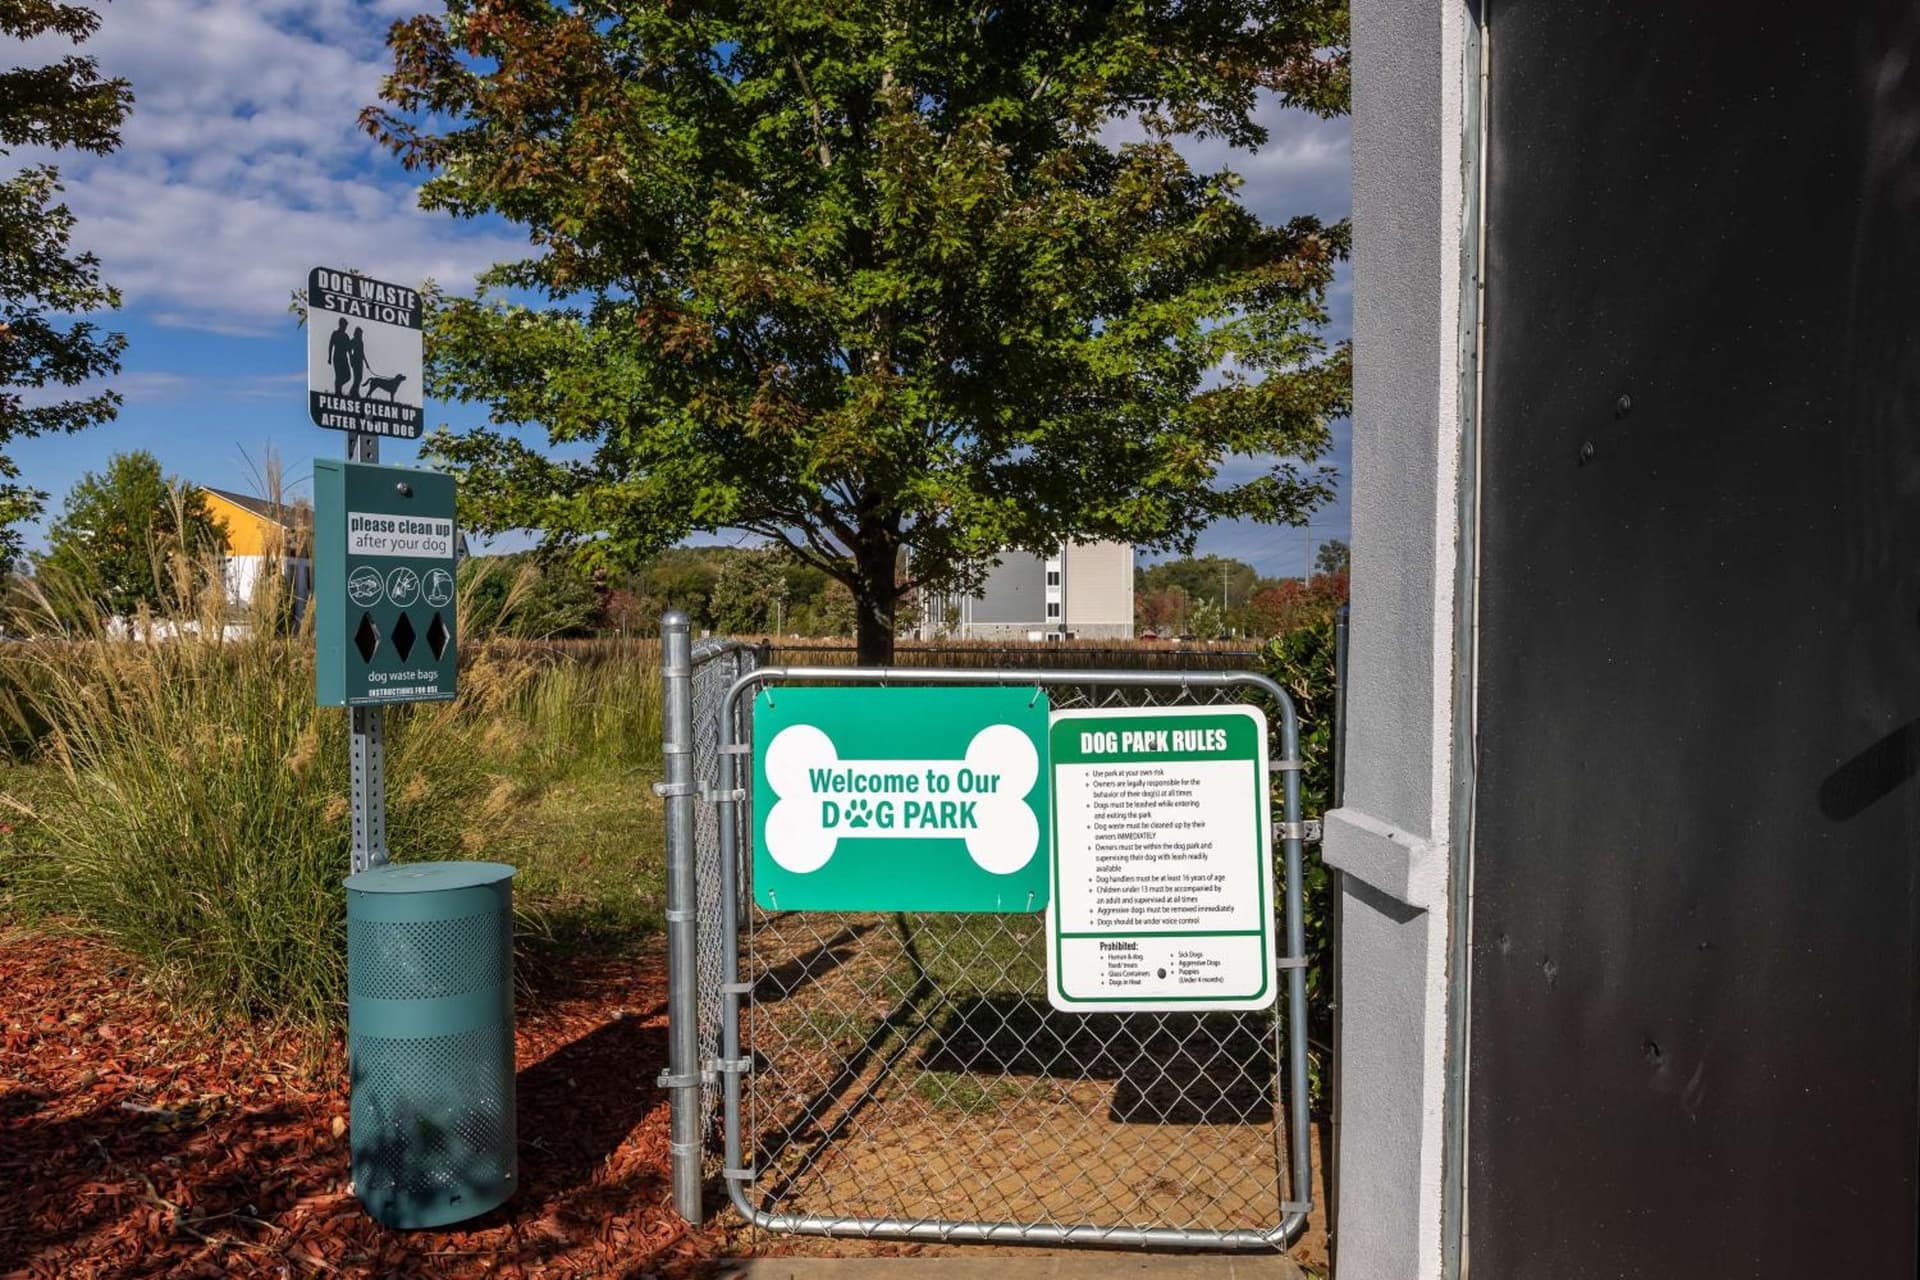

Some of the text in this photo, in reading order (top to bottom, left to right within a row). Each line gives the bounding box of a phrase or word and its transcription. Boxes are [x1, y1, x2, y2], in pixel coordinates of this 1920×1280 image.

[318, 270, 415, 308] DOG WASTE
[325, 294, 410, 326] STATION
[320, 395, 416, 421] PLEASE CLEAN UP
[322, 414, 414, 437] AFTER YOUR DOG
[352, 517, 449, 537] please clean up
[356, 533, 446, 553] after your dog
[368, 669, 438, 683] dog waste bags
[369, 687, 413, 696] INSTRUCTIONS
[1080, 729, 1227, 753] DOG PARK RULES
[1105, 769, 1118, 778] park
[809, 768, 1000, 793] Welcome to Our
[1127, 779, 1145, 788] legally
[1147, 779, 1179, 788] responsible
[1093, 790, 1119, 798] behavior
[1094, 802, 1109, 810] Dogs
[904, 801, 978, 828] PARK
[1107, 812, 1127, 820] exiting
[1094, 823, 1107, 831] Dog
[1151, 821, 1173, 829] cleaned
[1175, 822, 1182, 830] up
[1184, 821, 1191, 830] by
[1117, 832, 1156, 840] IMMEDIATELY
[1174, 843, 1186, 851] dog
[1187, 843, 1199, 851] park
[1096, 855, 1128, 863] supervising
[1144, 854, 1156, 862] dog
[1188, 853, 1208, 861] readily
[1096, 876, 1108, 884] Dog
[1174, 885, 1213, 893] accompanied
[1214, 885, 1221, 893] by
[1134, 896, 1165, 905] supervised
[1098, 908, 1129, 916] Aggressive
[1130, 907, 1145, 915] dogs
[1198, 905, 1234, 913] immediately
[1097, 918, 1112, 926] Dogs
[1100, 941, 1138, 951] Prohibited:
